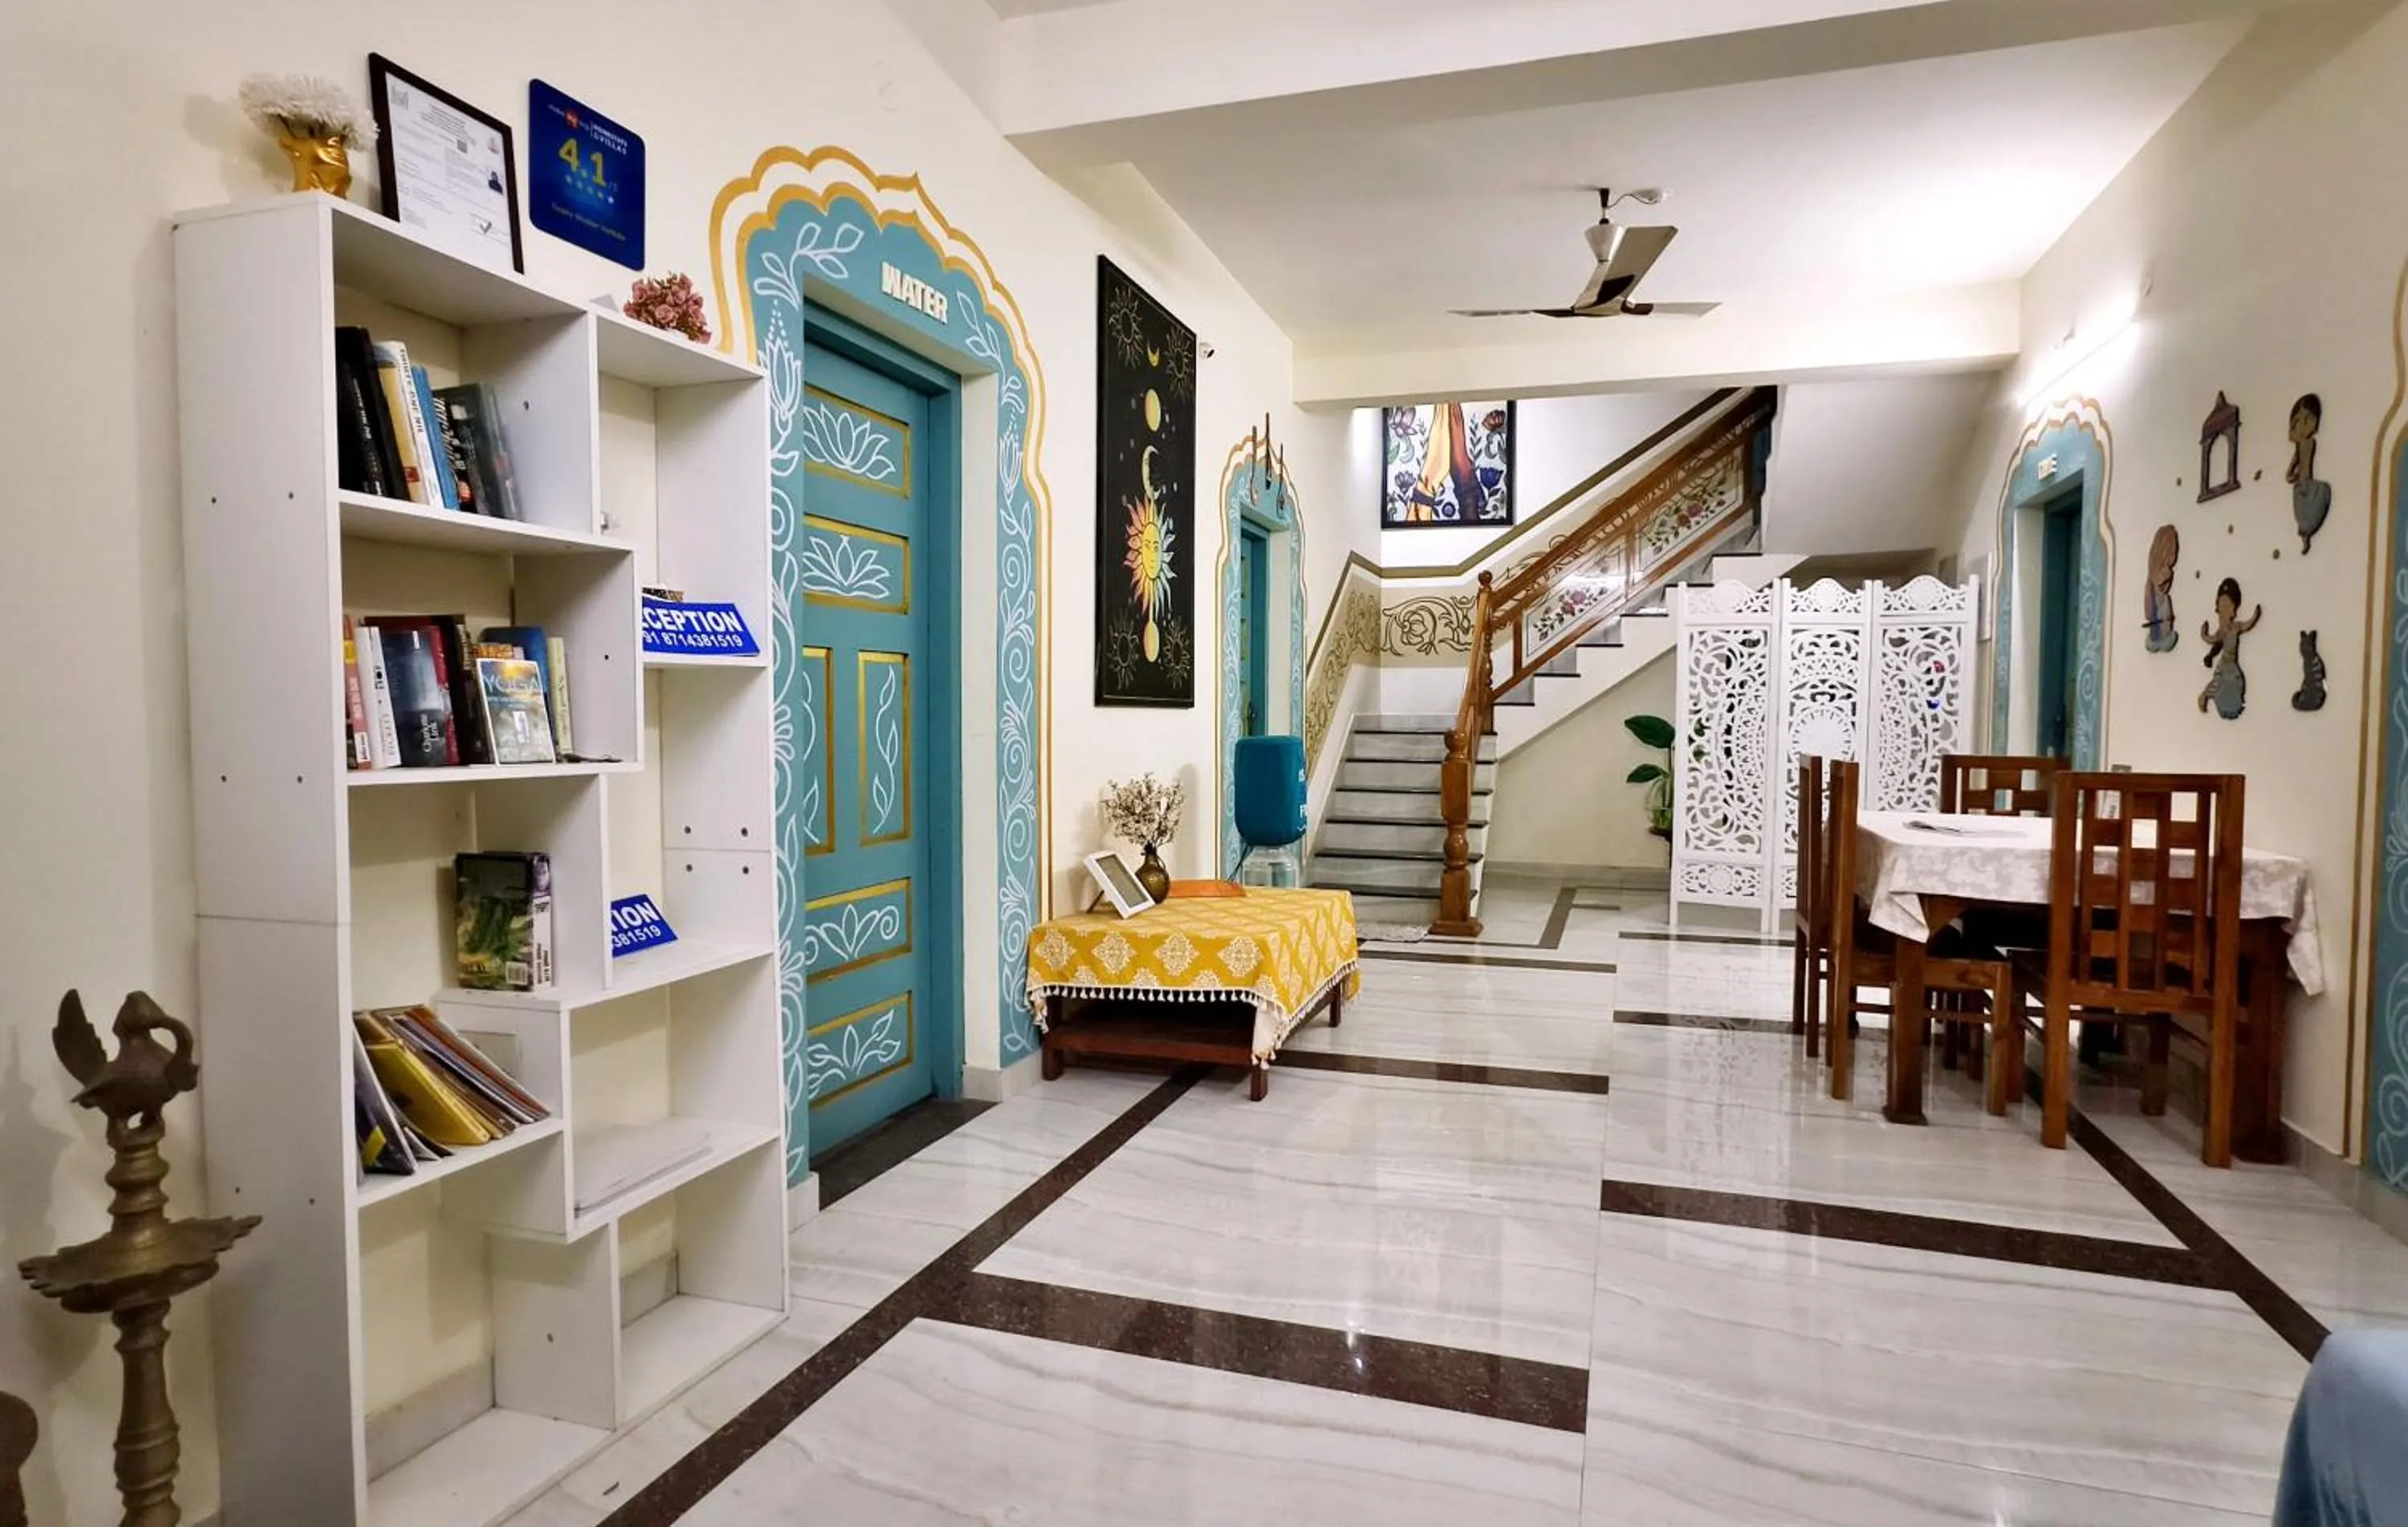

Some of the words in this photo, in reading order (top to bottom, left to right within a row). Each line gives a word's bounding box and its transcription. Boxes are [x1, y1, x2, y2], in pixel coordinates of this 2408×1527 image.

[559, 138, 607, 186] 4.1
[881, 260, 948, 324] WATER
[642, 607, 743, 633] CEPTION
[661, 633, 743, 649] 8714381519
[483, 674, 541, 694] YOGA
[610, 924, 661, 949] 381519
